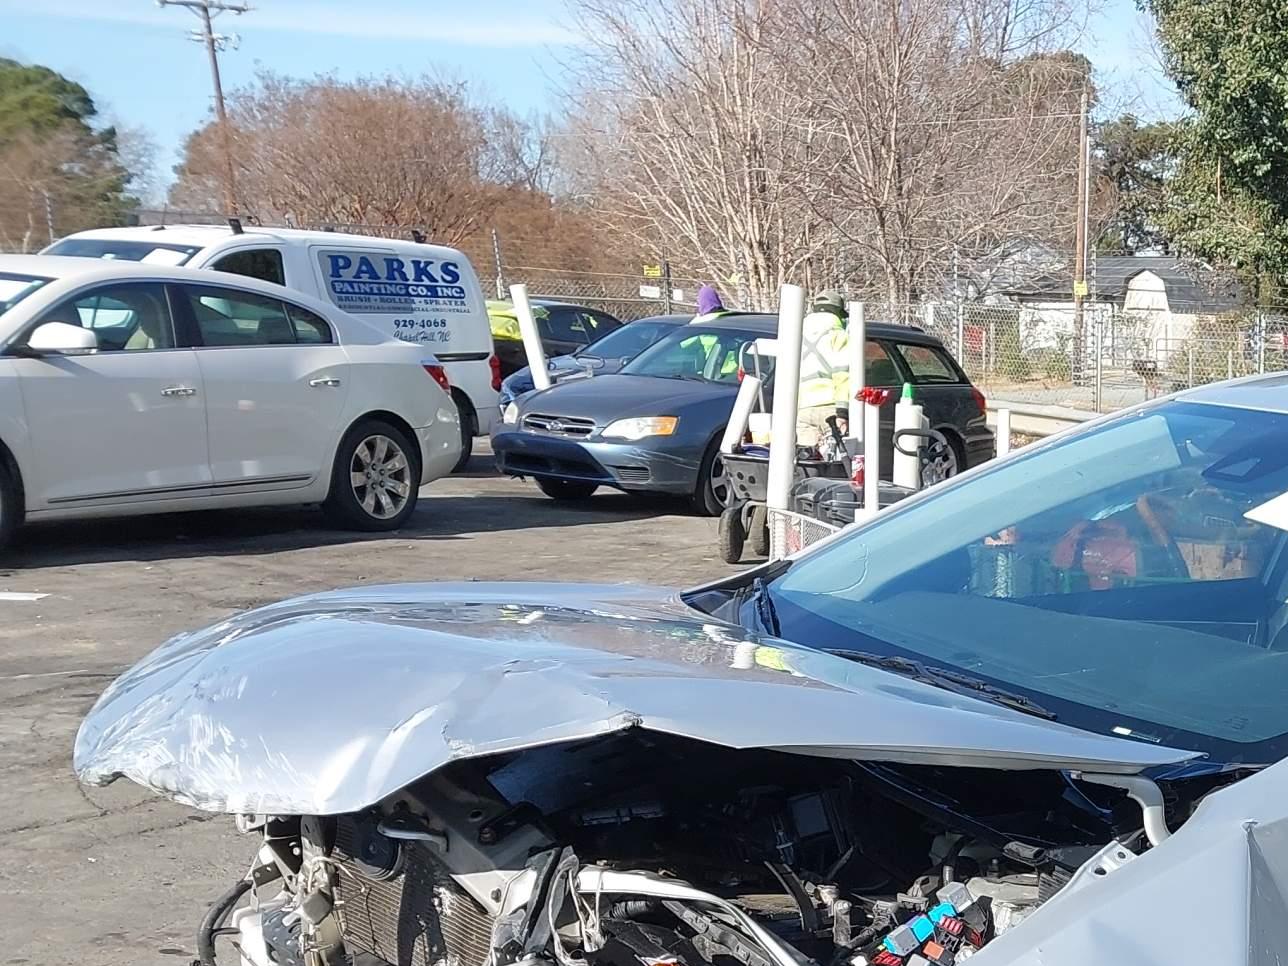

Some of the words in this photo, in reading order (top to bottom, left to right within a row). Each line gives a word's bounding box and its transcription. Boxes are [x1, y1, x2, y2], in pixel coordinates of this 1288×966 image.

[328, 255, 461, 284] PARKS
[334, 281, 406, 295] PAINTING
[408, 285, 431, 296] CO.
[438, 287, 465, 297] INC.
